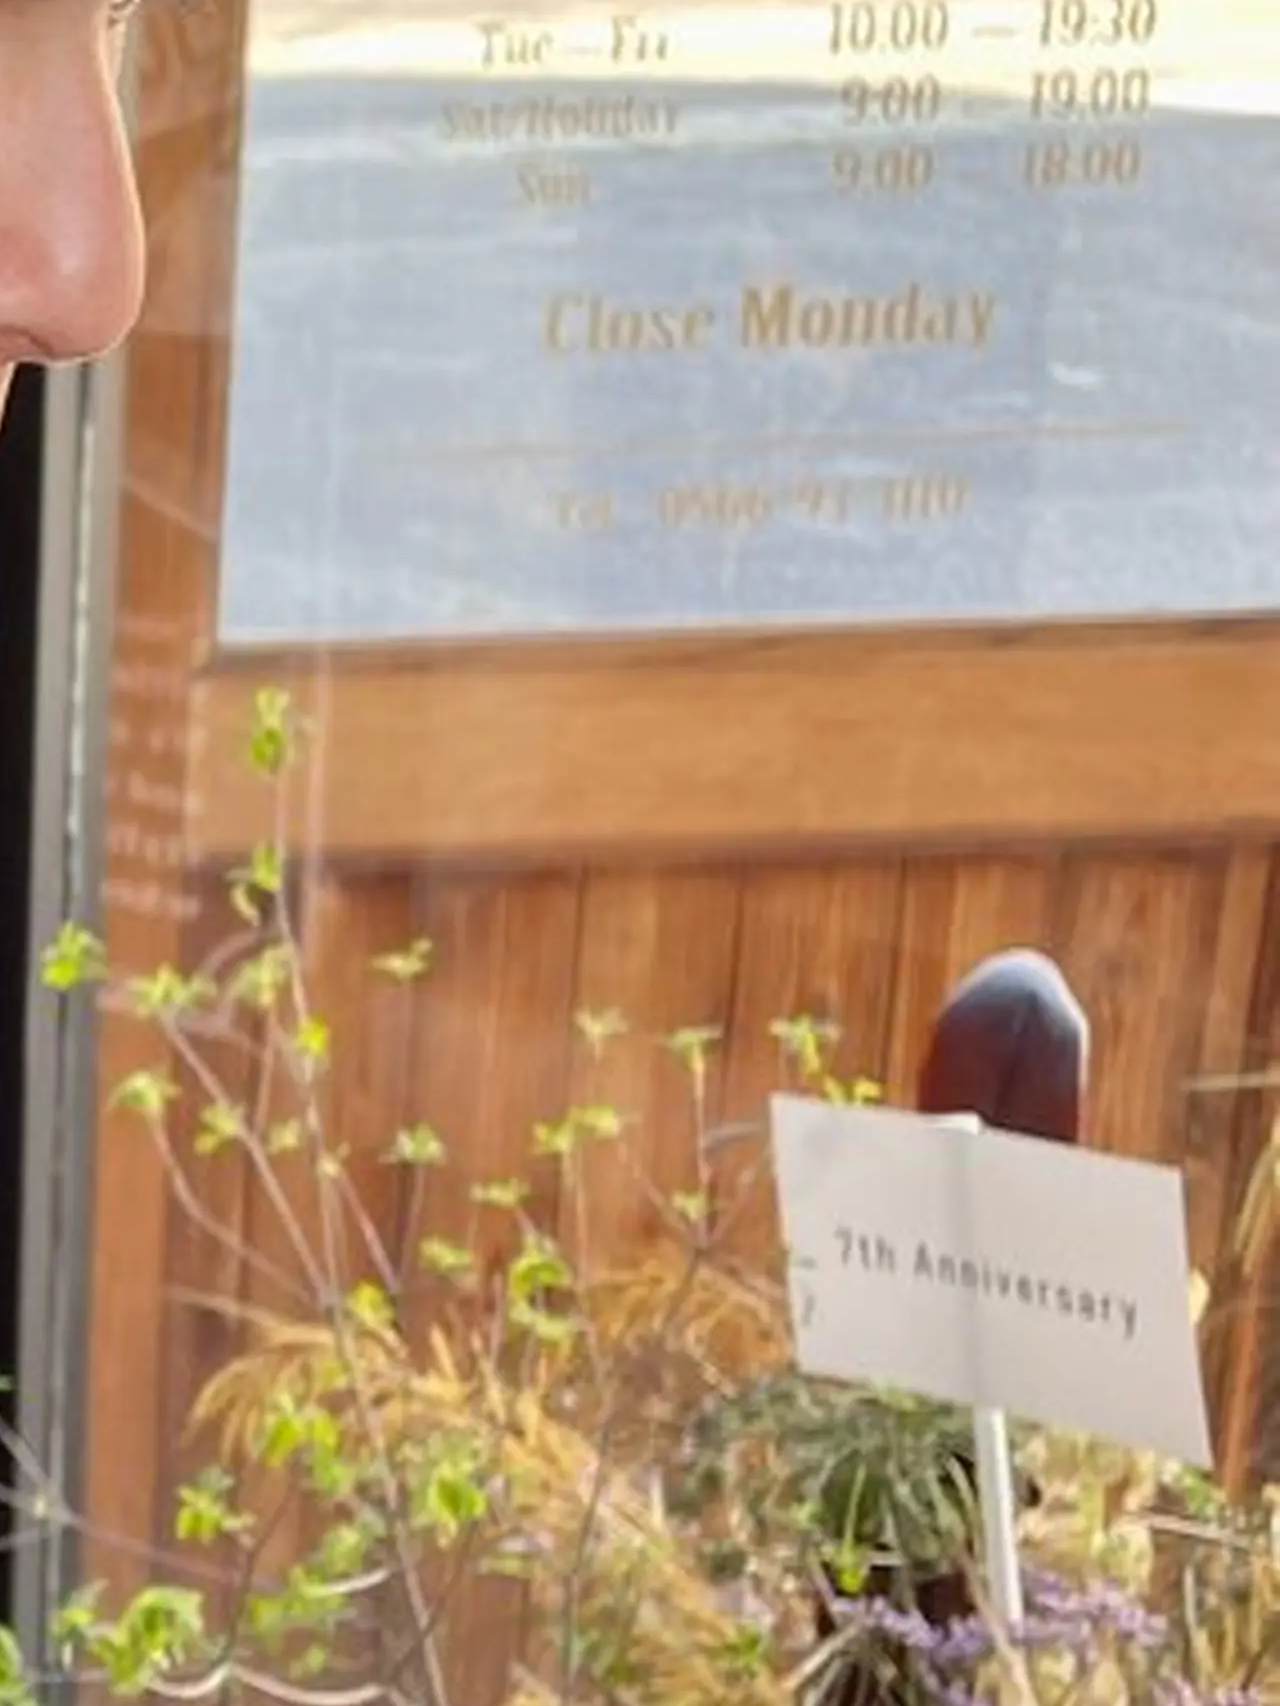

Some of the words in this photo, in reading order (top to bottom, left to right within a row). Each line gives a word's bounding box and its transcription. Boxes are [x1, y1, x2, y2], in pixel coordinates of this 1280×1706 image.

[540, 289, 716, 357] Close
[739, 279, 1000, 355] Monday
[833, 1225, 897, 1275] 7th
[913, 1240, 1138, 1341] Anniversary
